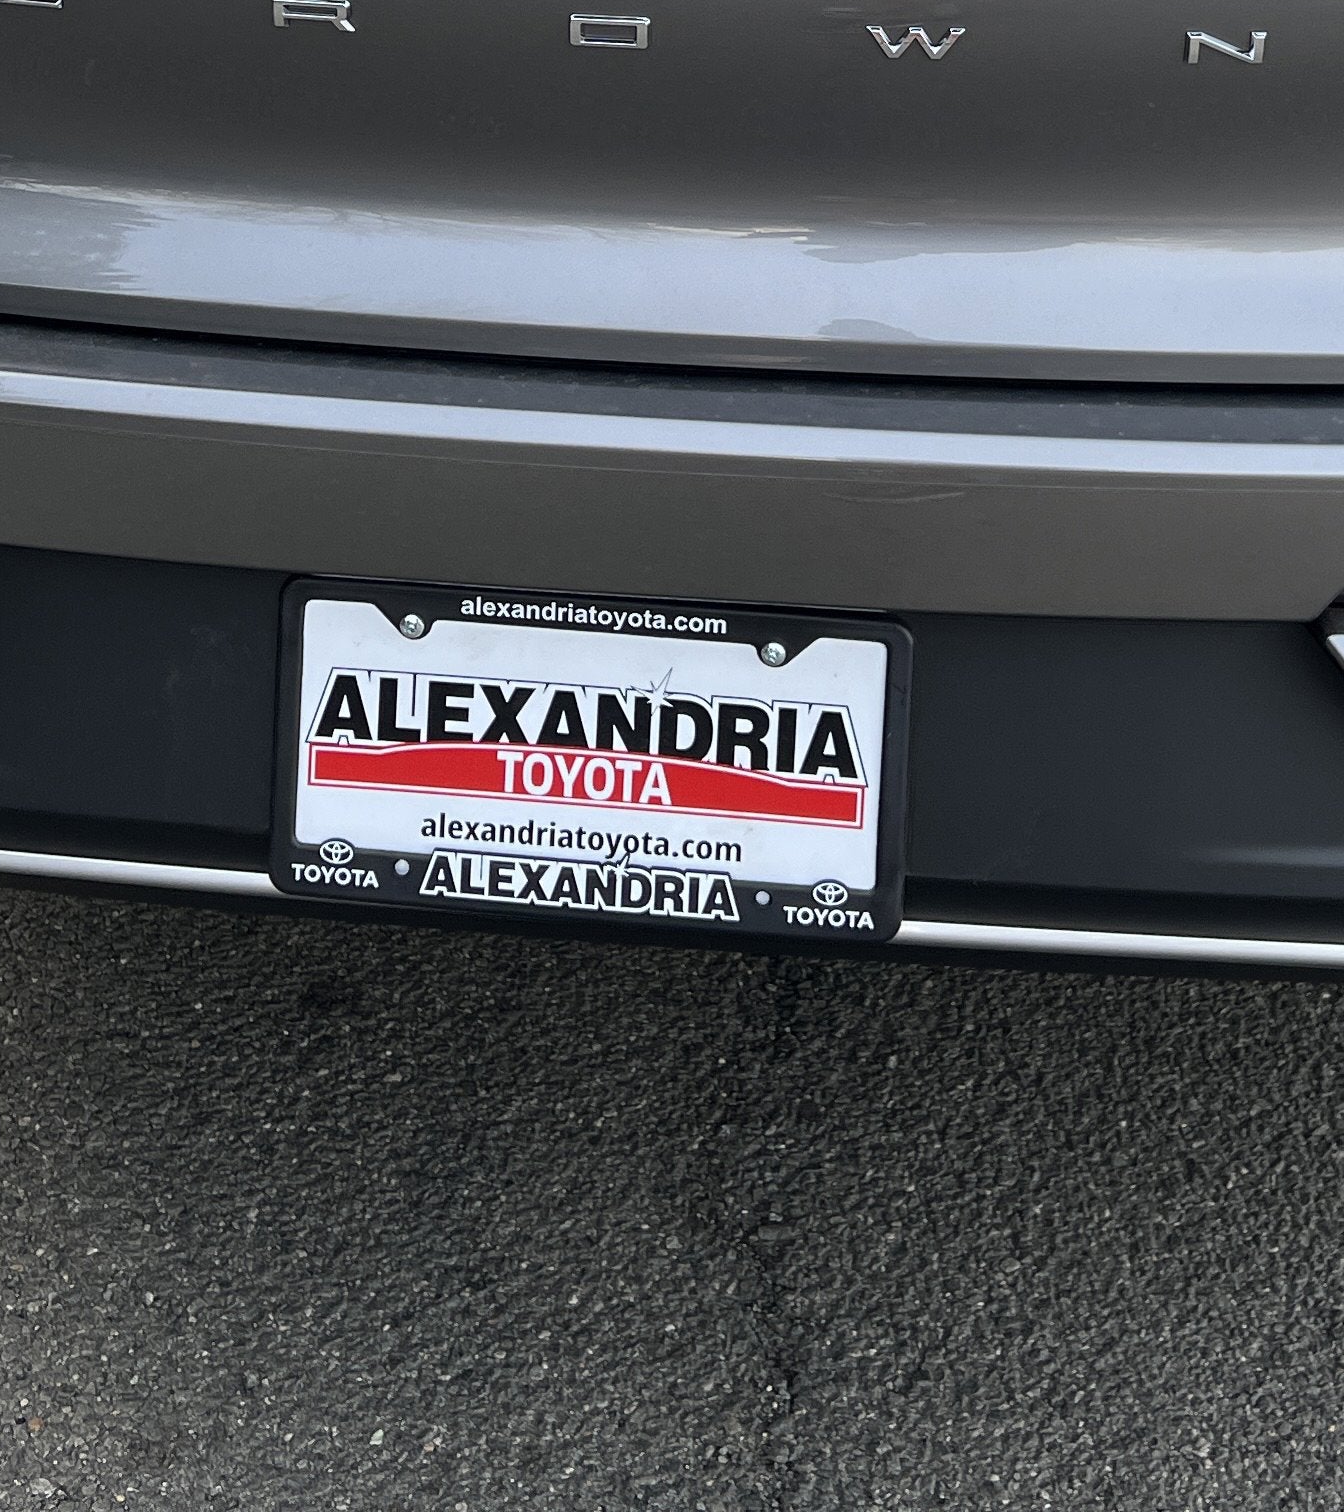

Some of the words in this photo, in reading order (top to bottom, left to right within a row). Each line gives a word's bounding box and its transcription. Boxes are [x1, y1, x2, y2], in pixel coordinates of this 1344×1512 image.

[459, 595, 728, 635] alexandriatoyota.com
[310, 670, 863, 782] ALEXANDRIA
[496, 749, 673, 806] TOYOTA
[420, 812, 742, 863] alexandriatoyota.com
[290, 862, 380, 889] TOYOTA
[419, 850, 740, 921] ALEXANDRIA
[782, 905, 875, 930] TOYOTA
